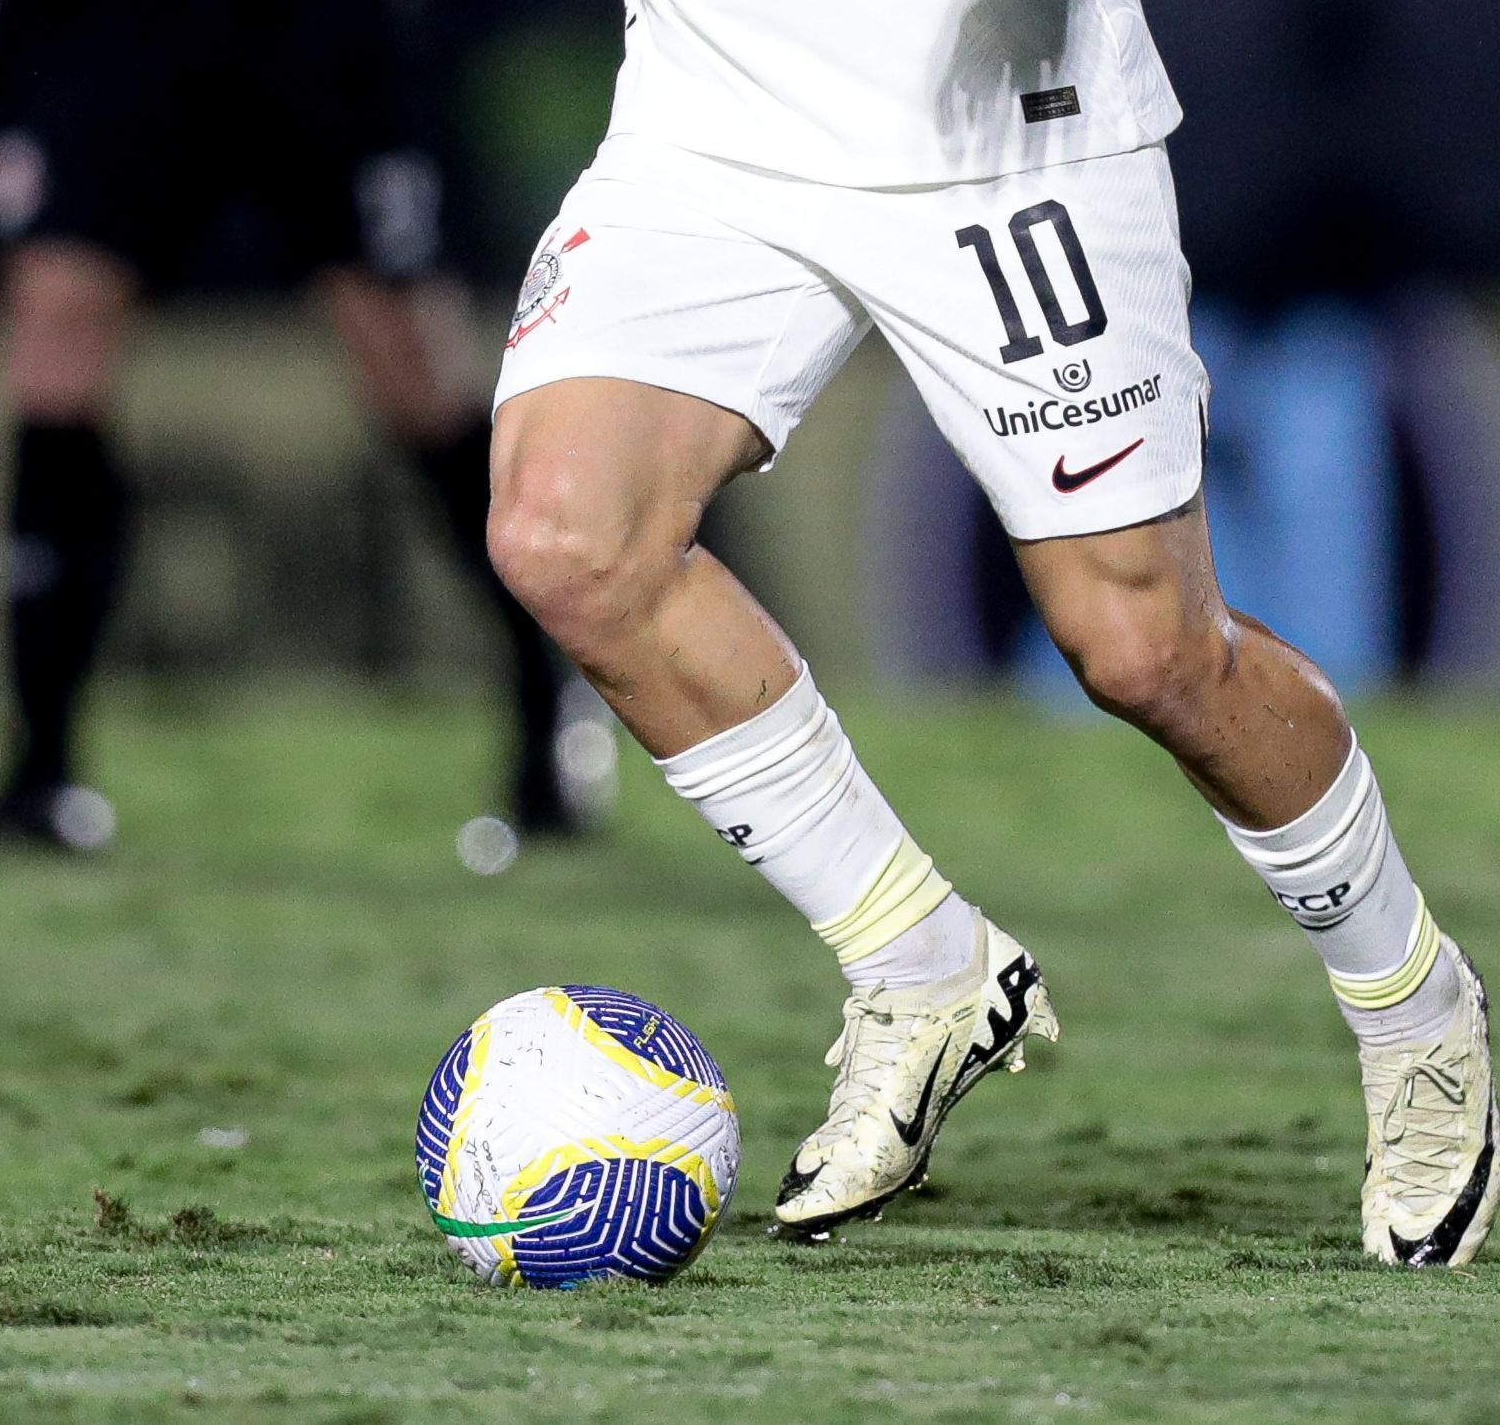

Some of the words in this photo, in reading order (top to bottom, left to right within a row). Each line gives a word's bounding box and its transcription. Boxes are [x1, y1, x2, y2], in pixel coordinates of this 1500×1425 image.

[955, 199, 1108, 365] 10
[983, 373, 1162, 437] UniCesumar
[1266, 880, 1351, 911] CCP
